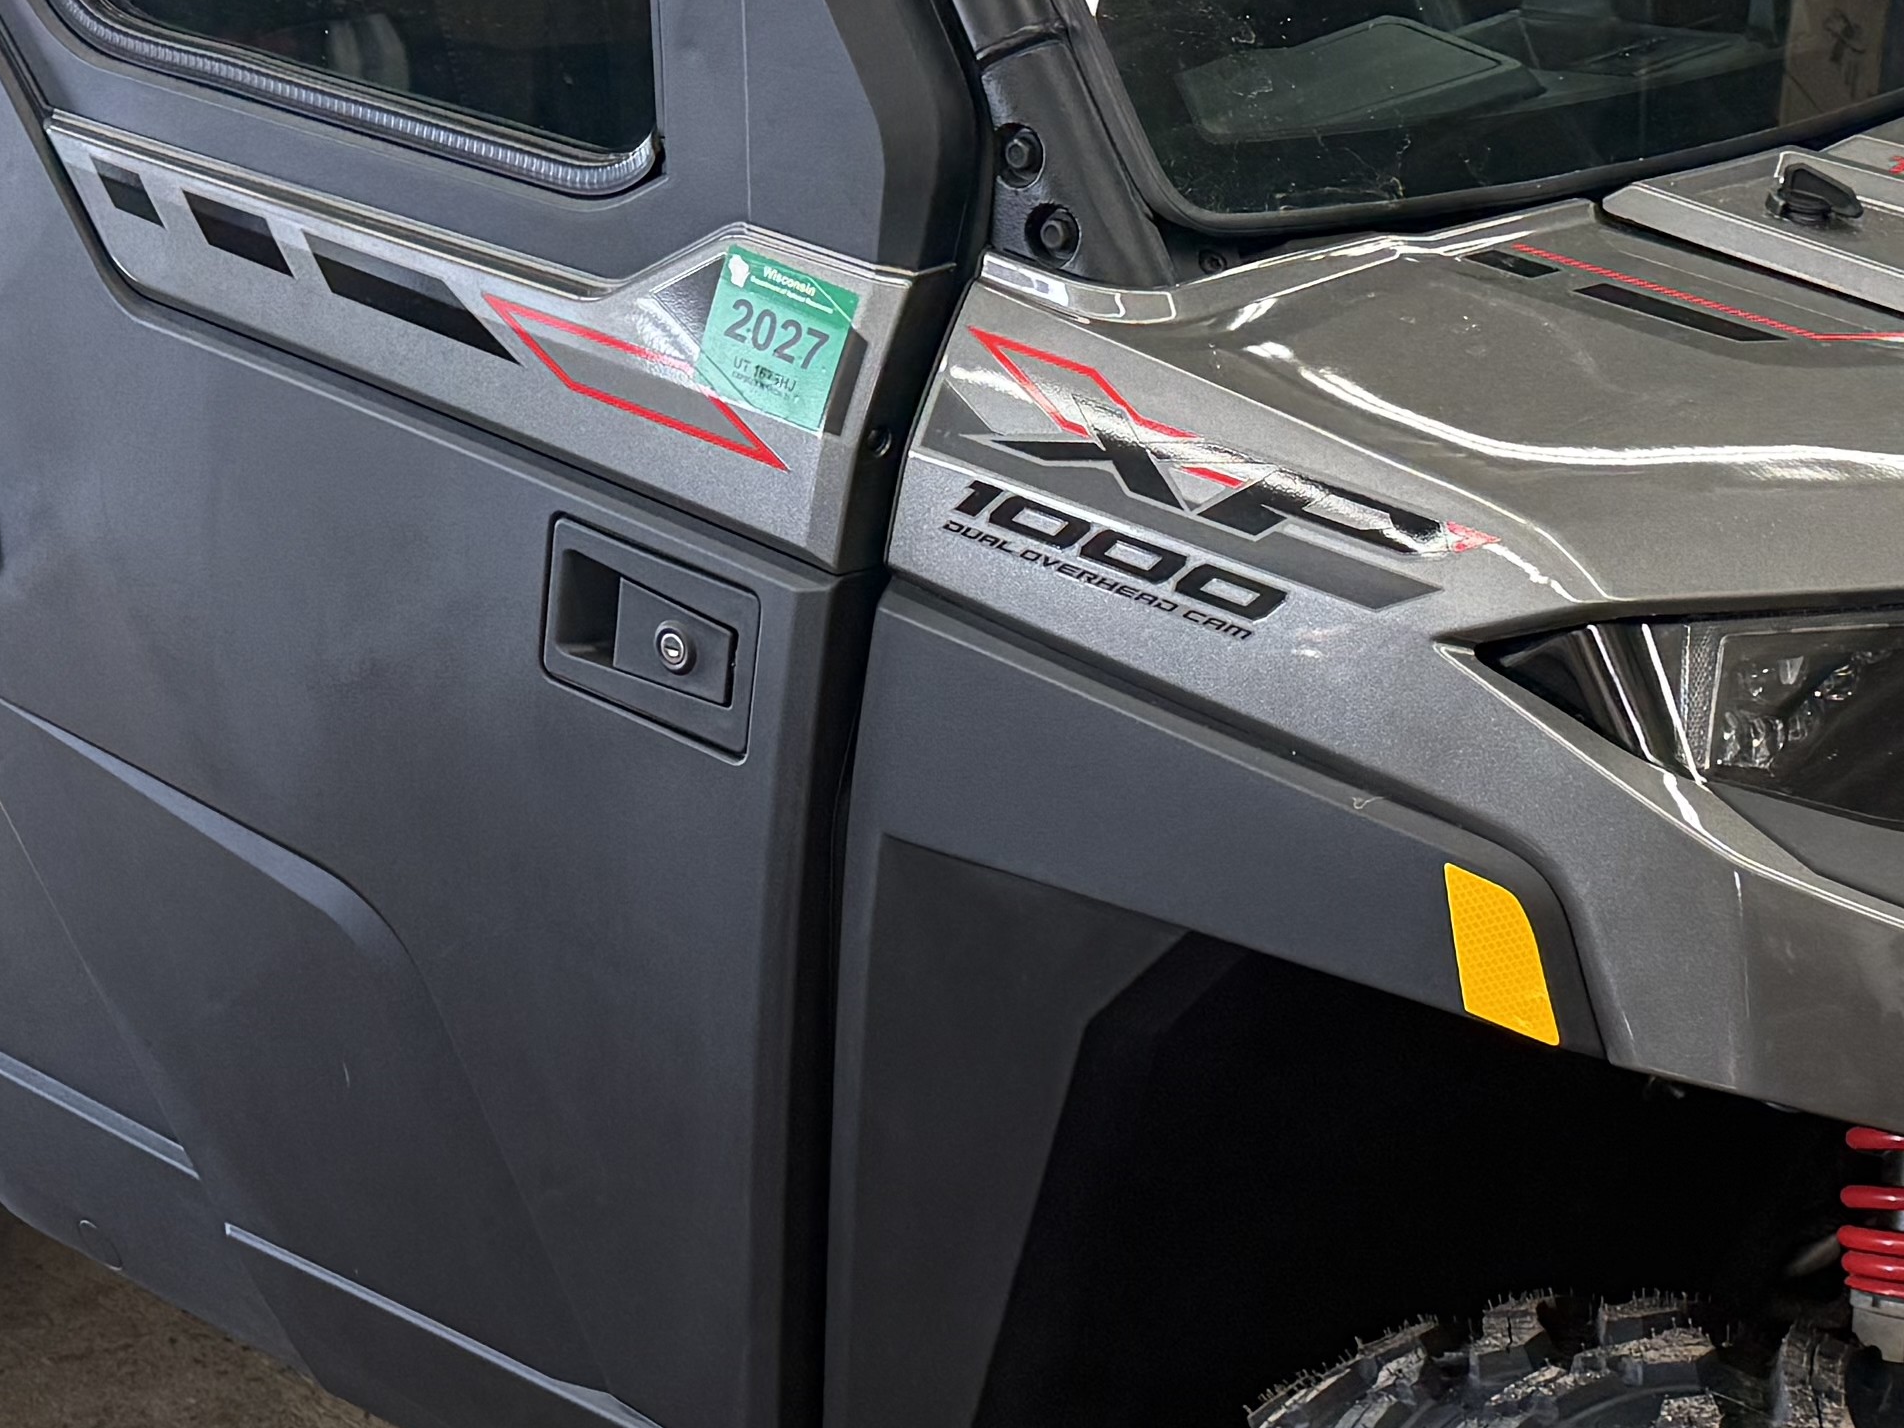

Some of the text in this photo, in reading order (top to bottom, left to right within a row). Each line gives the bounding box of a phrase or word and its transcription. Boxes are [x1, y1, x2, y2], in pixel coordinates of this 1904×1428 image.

[762, 265, 816, 297] Wisconsin
[723, 298, 831, 370] 2027
[942, 518, 1255, 642] DUAL OVERHEAD CAM
[944, 478, 1288, 625] 1000
